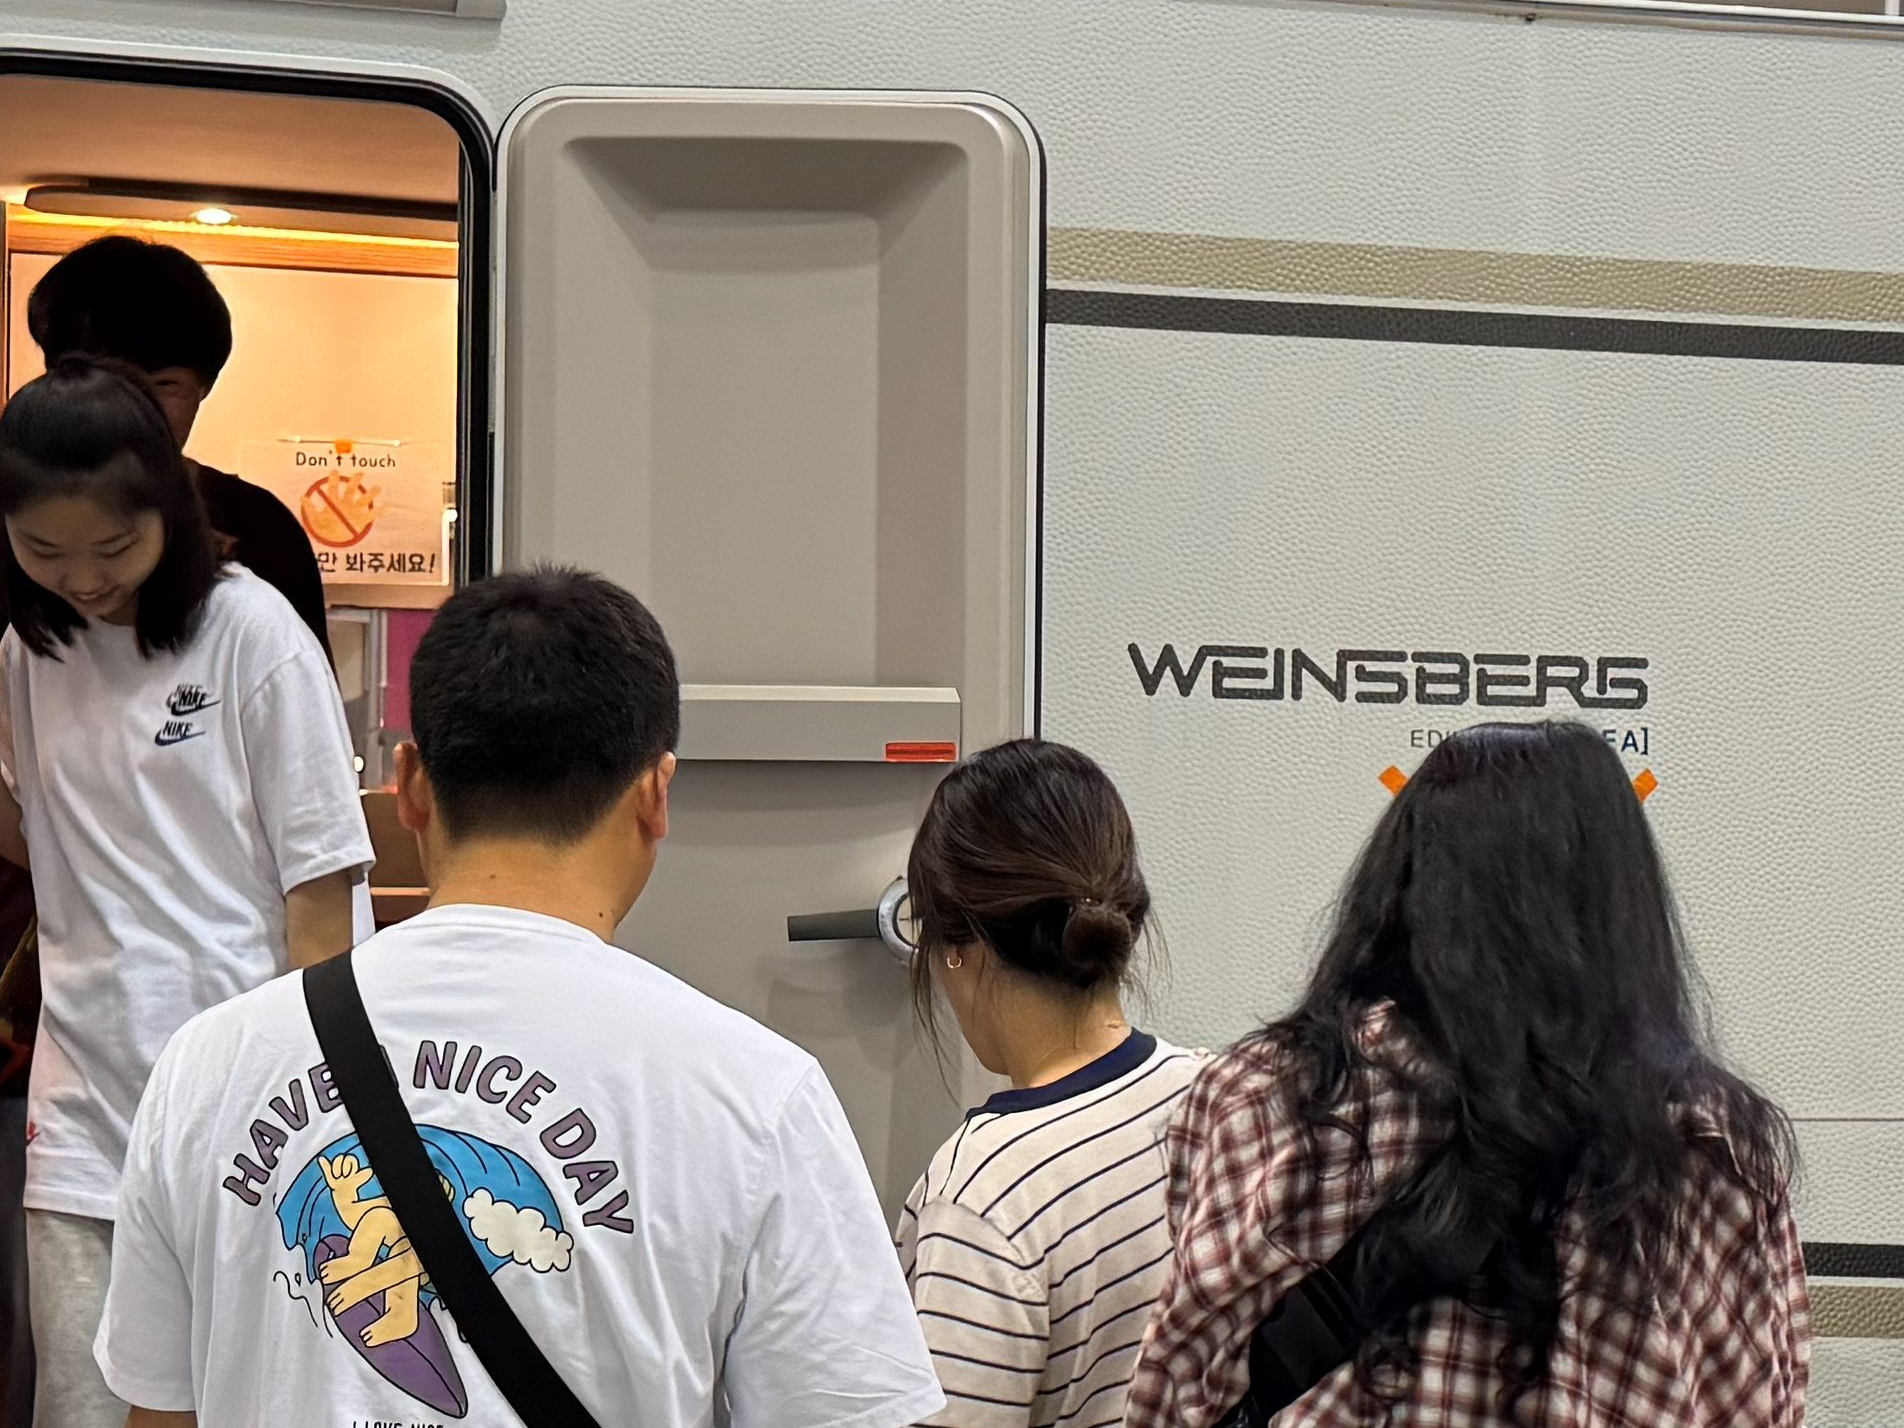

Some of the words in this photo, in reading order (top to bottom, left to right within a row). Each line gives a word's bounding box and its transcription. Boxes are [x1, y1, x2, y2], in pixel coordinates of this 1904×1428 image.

[351, 453, 396, 468] touch
[346, 551, 436, 573] 봐주세요!
[162, 721, 194, 737] NIKE
[223, 1061, 343, 1207] HAVE
[413, 1040, 556, 1124] NICE
[540, 1108, 635, 1236] DAY
